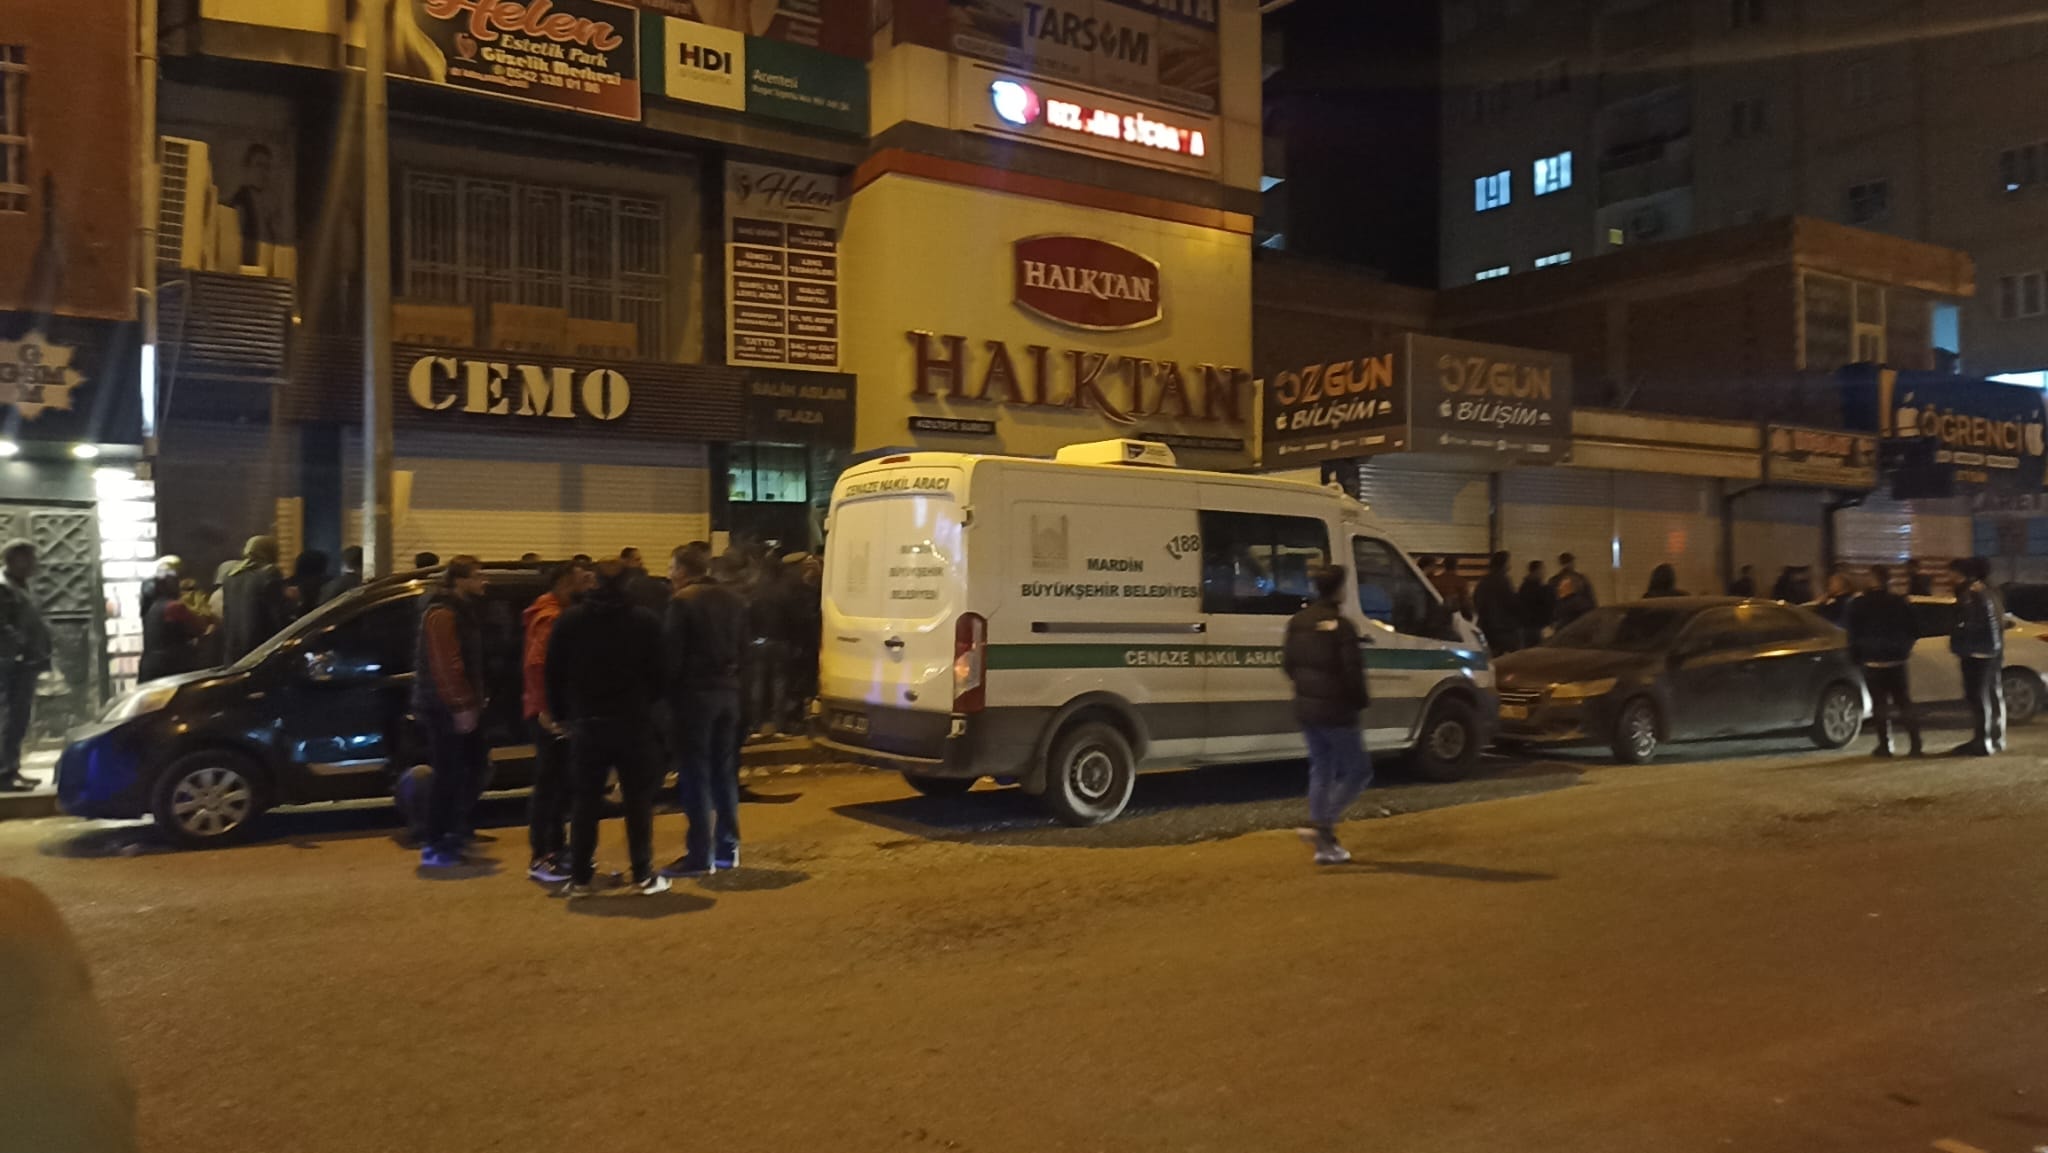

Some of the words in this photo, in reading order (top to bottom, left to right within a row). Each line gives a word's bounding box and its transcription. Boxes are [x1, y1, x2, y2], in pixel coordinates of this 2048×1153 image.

[426, 0, 624, 51] Helen
[568, 48, 608, 68] Park
[679, 42, 732, 74] HDI
[1024, 260, 1153, 303] HALKTAN
[408, 355, 631, 421] CEMO
[906, 330, 1248, 425] HALKTAN
[1291, 398, 1375, 431] BİLİŞİM
[1456, 398, 1537, 429] BİLİŞİM
[1921, 404, 2023, 452] ÖĞRENCİ
[912, 477, 949, 490] ARACI
[1172, 534, 1200, 551] 188
[1087, 556, 1143, 572] MARDİN
[1021, 581, 1119, 600] BÜYÜKŞEHİR
[1125, 651, 1188, 665] CENAZE
[1195, 650, 1240, 665] NAKİL
